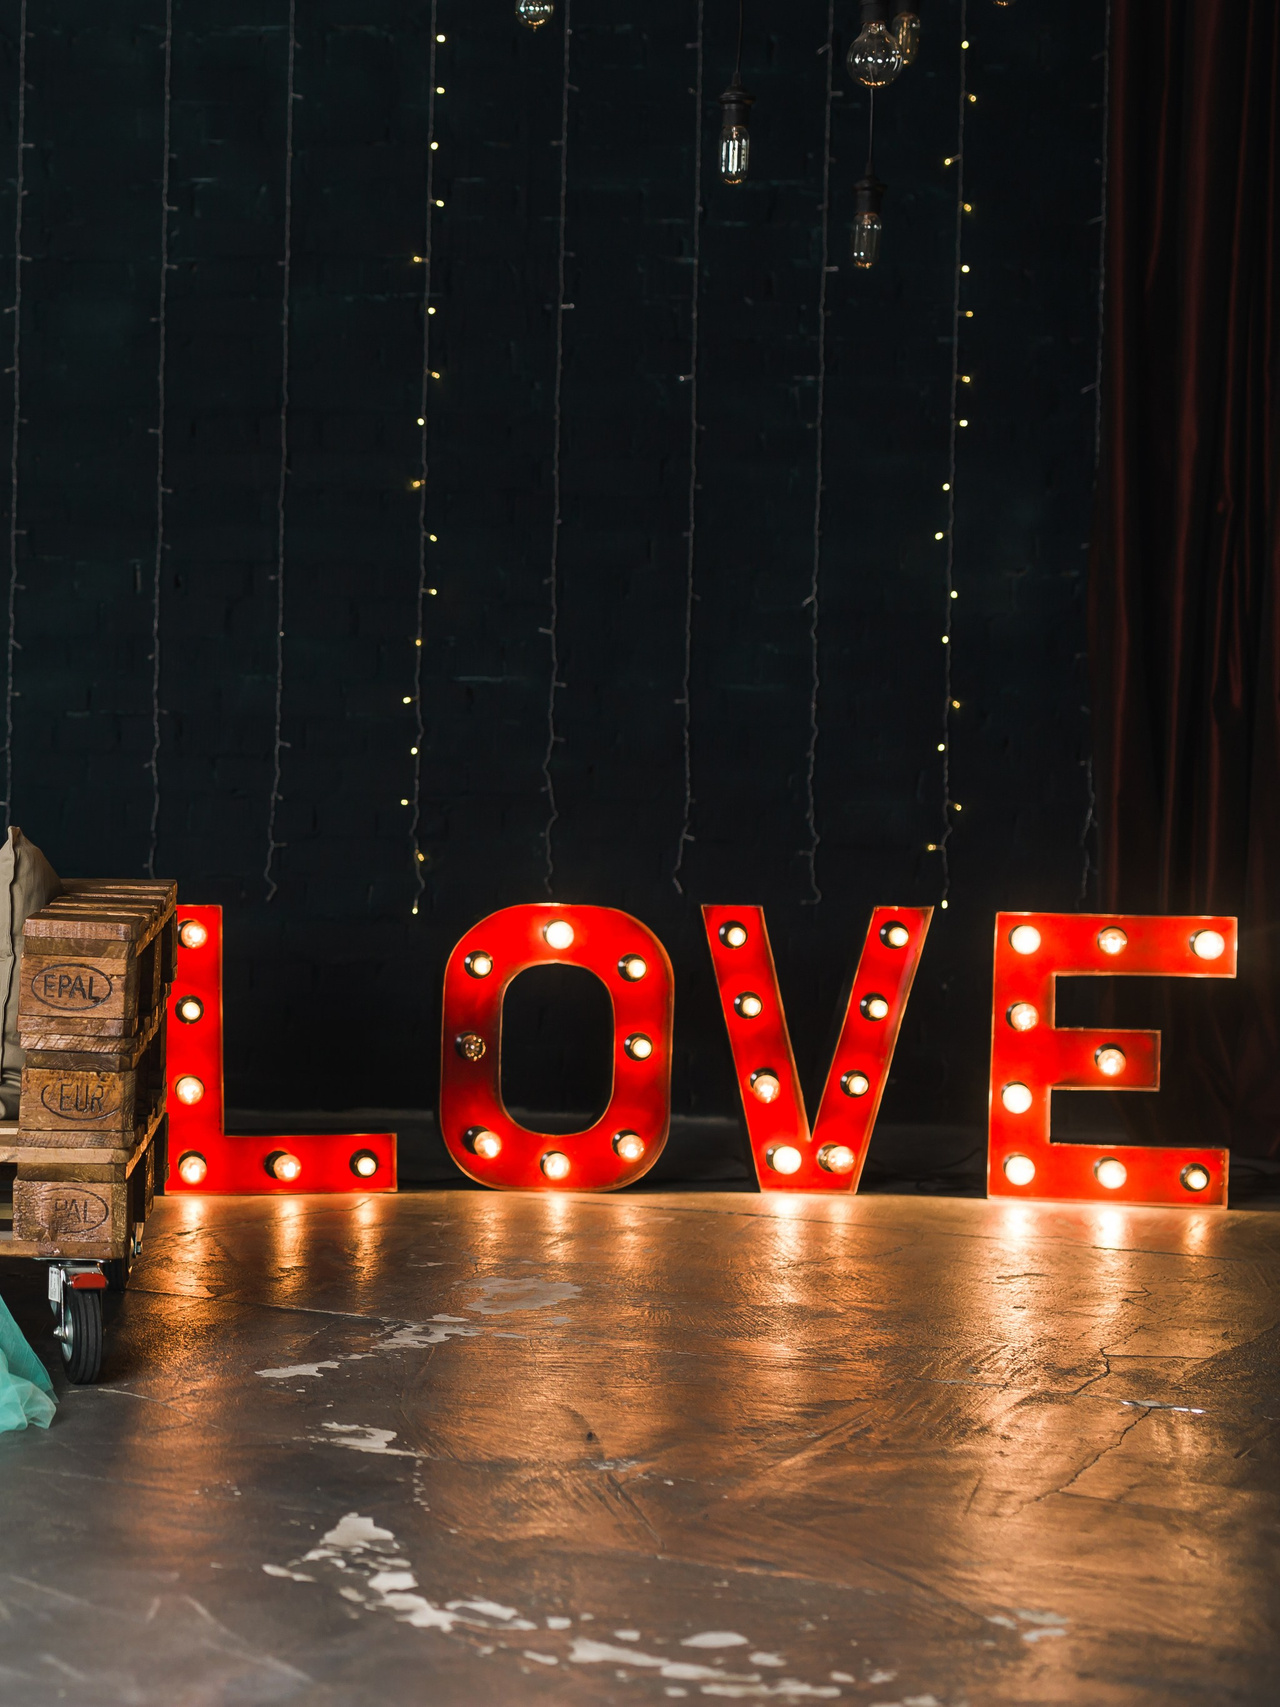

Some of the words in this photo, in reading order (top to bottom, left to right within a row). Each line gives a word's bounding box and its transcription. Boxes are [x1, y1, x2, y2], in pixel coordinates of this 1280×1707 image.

[43, 973, 101, 1001] EPAL
[164, 902, 1238, 1209] LOVE
[60, 1083, 104, 1112] EUR
[42, 1197, 96, 1224] PAL
